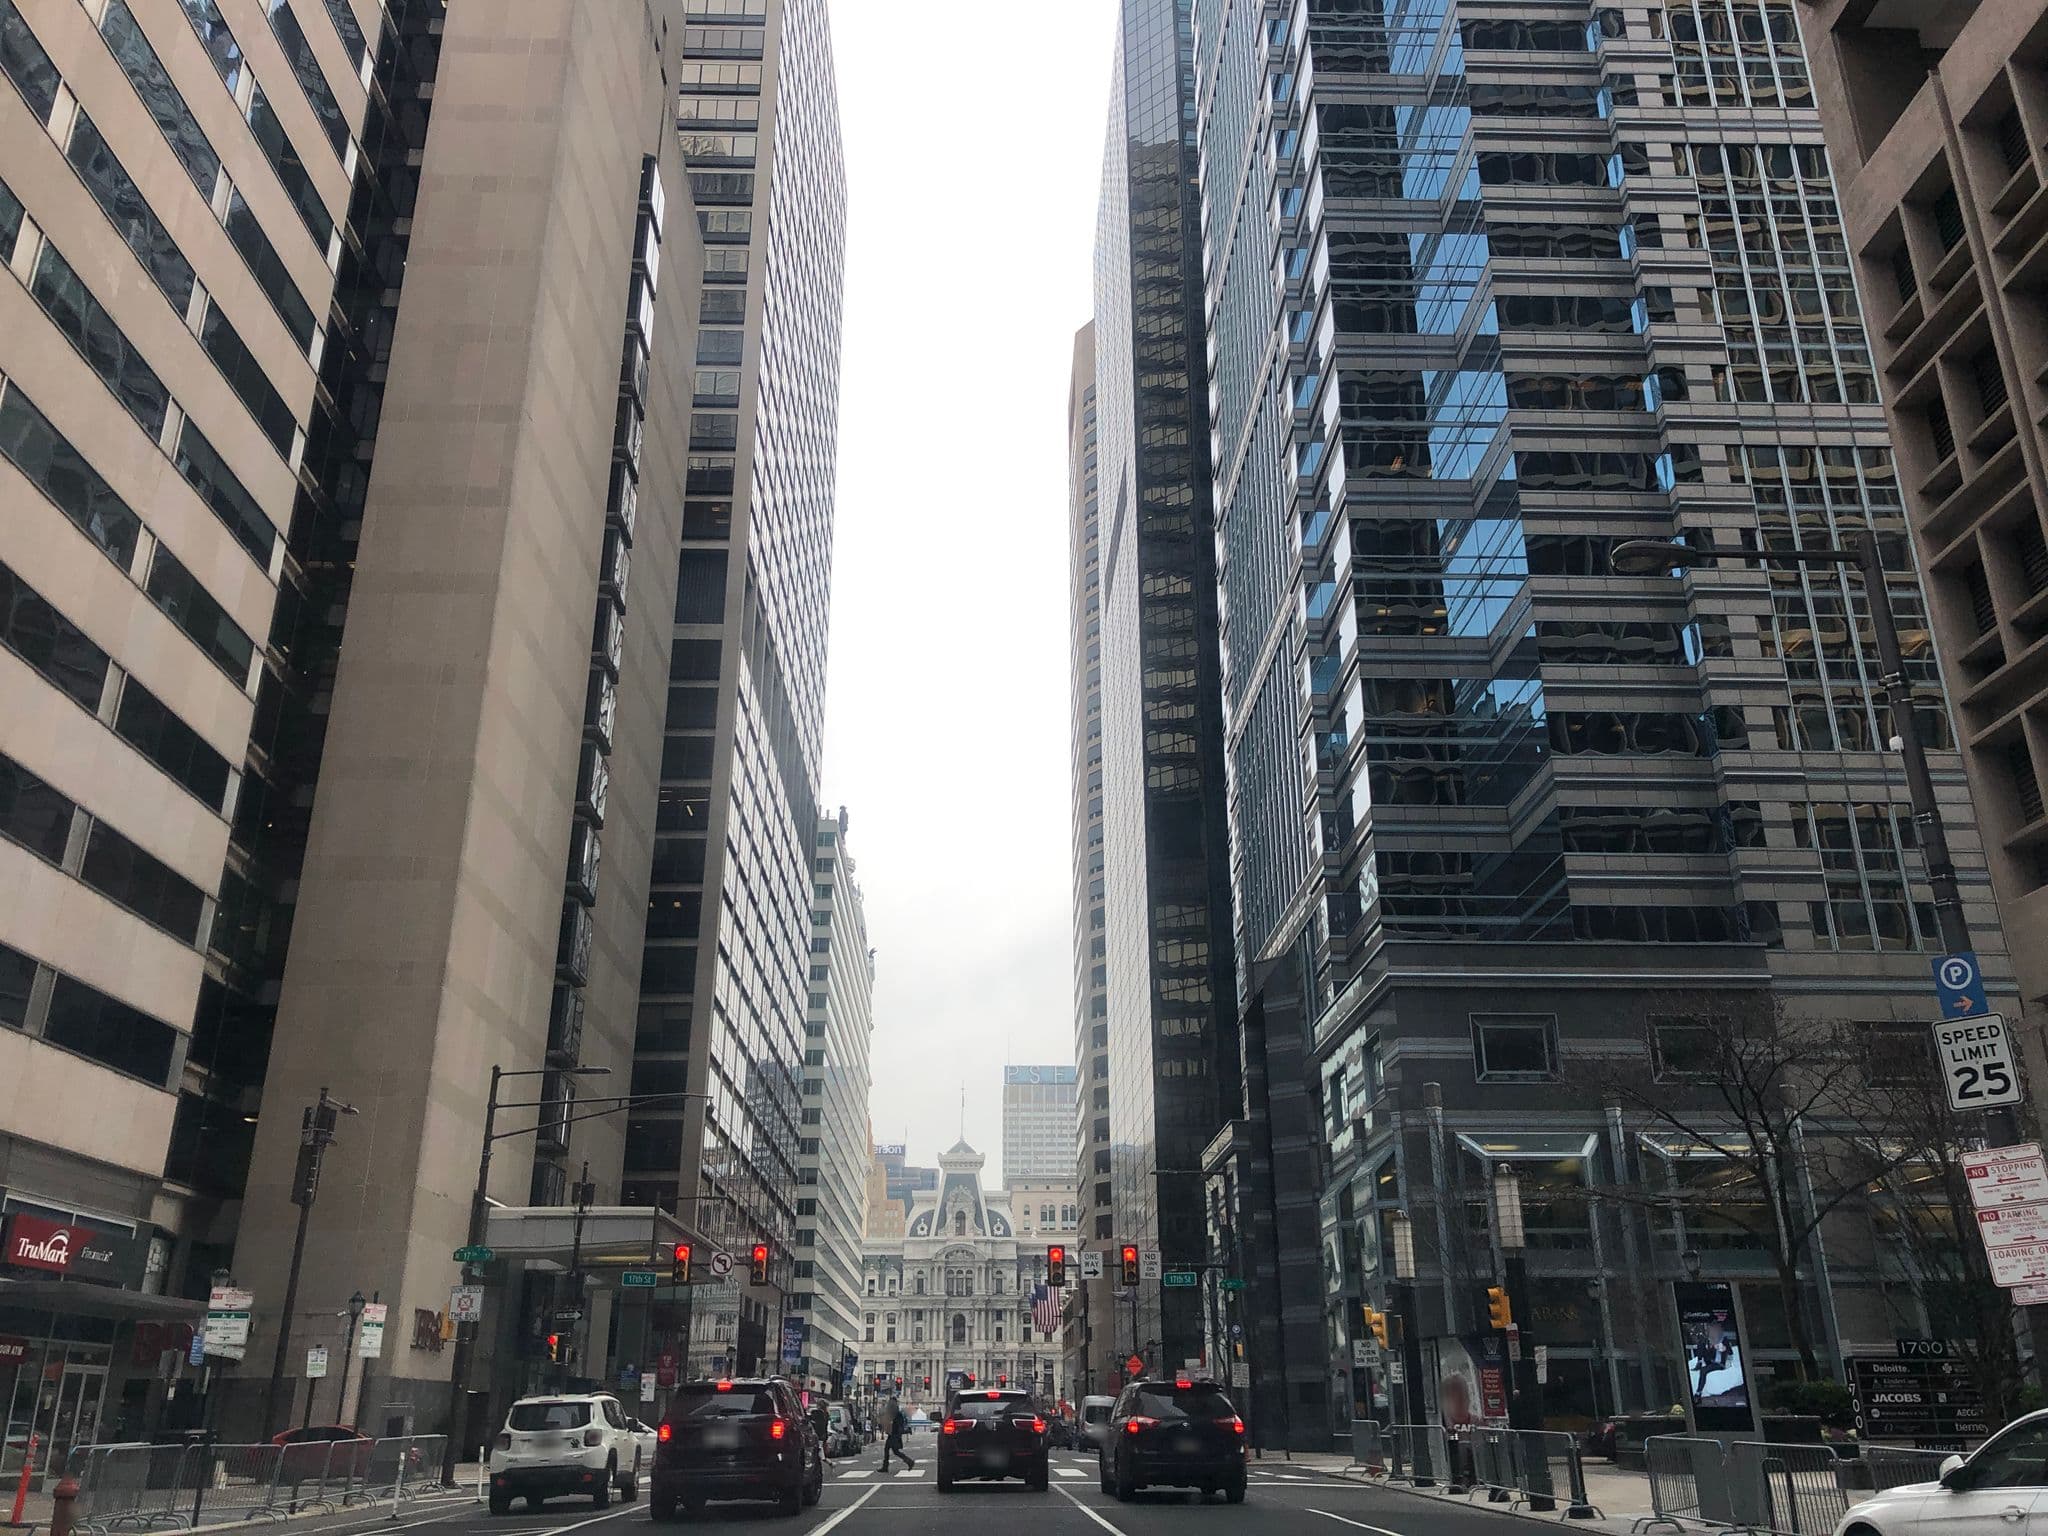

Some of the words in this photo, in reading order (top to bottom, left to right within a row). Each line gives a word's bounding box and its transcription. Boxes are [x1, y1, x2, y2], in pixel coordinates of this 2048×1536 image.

[1949, 966, 1962, 982] P
[1942, 1025, 2000, 1045] SPEED
[1951, 1043, 1997, 1062] LIMIT
[1953, 1061, 2011, 1100] 25
[1971, 1168, 1985, 1177] NO
[1990, 1160, 2037, 1174] STOPPING
[2001, 1208, 2038, 1219] PARKING
[17, 1236, 69, 1265] TruMark
[1993, 1247, 2034, 1259] LOADING
[1084, 1260, 1099, 1268] WAY
[1901, 1341, 1943, 1354] 1700
[1872, 1393, 1922, 1403] JACOBS
